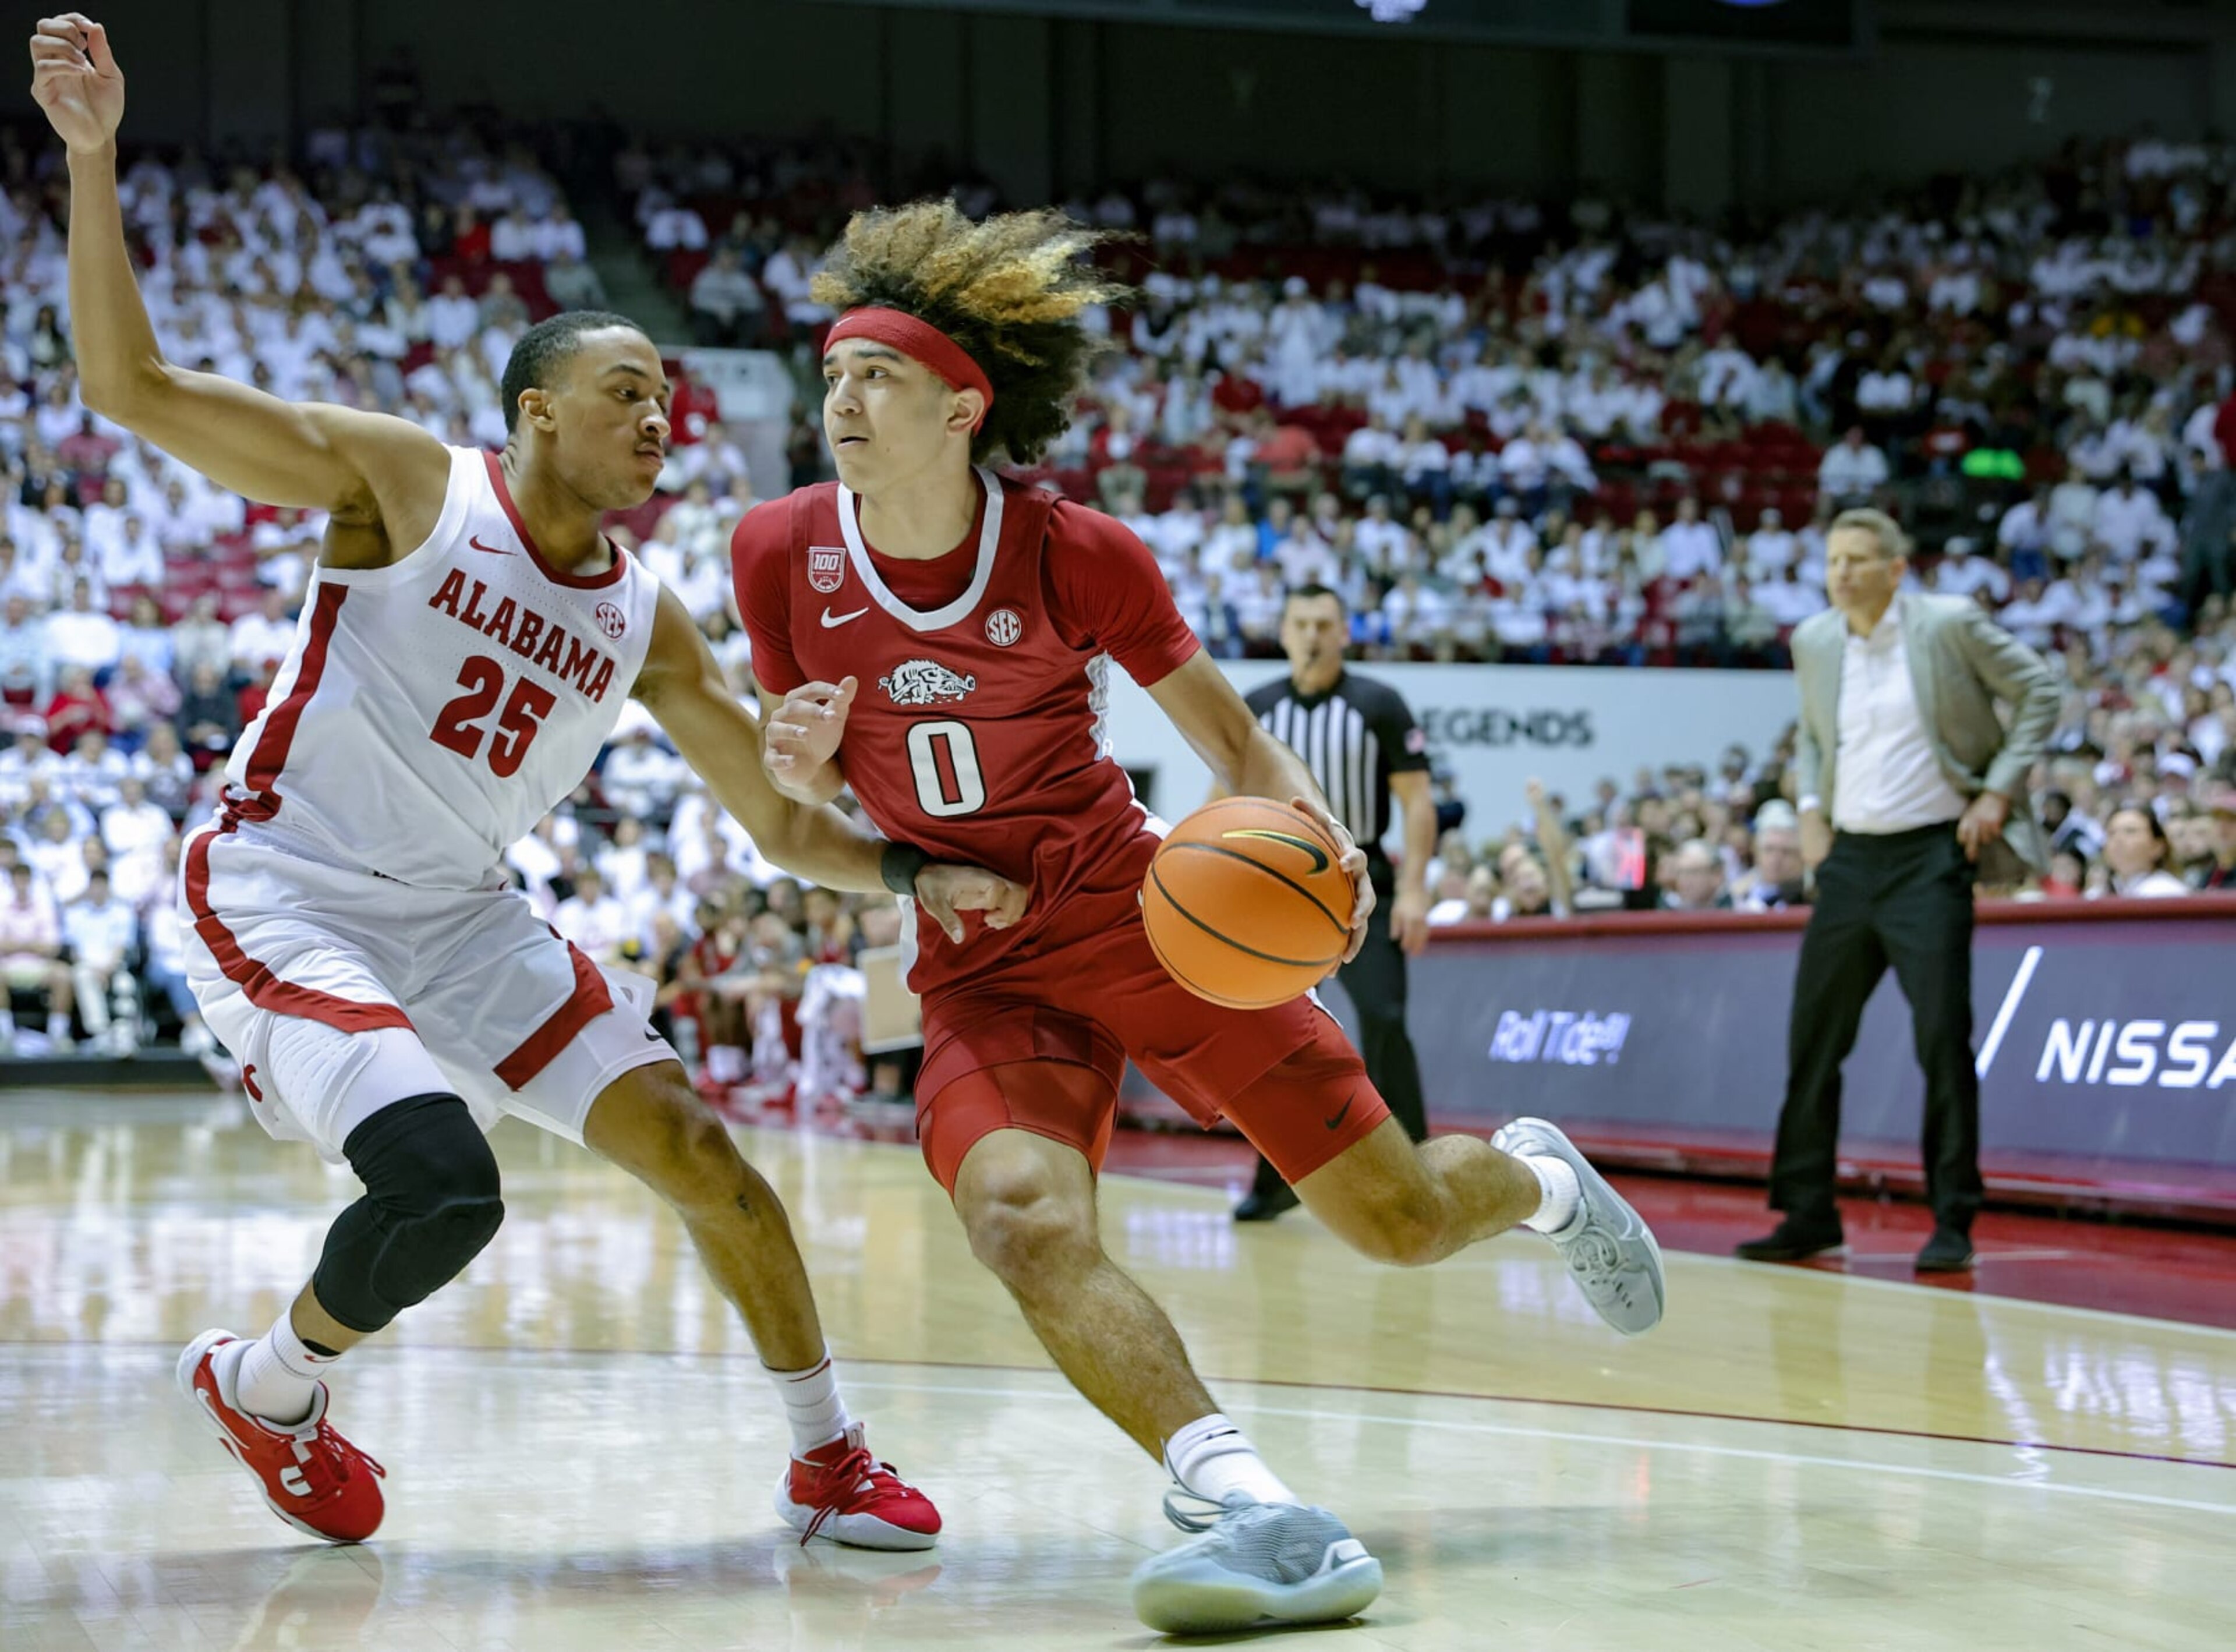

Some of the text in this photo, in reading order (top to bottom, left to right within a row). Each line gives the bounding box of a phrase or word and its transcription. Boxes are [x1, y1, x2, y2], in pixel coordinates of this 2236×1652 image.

[815, 554, 839, 570] 100
[429, 567, 615, 703] ALABAMA
[597, 604, 624, 638] SEC
[989, 612, 1018, 643] SEC
[429, 655, 557, 778] 25
[1421, 706, 1594, 749] EGENDS
[906, 719, 987, 818] 0
